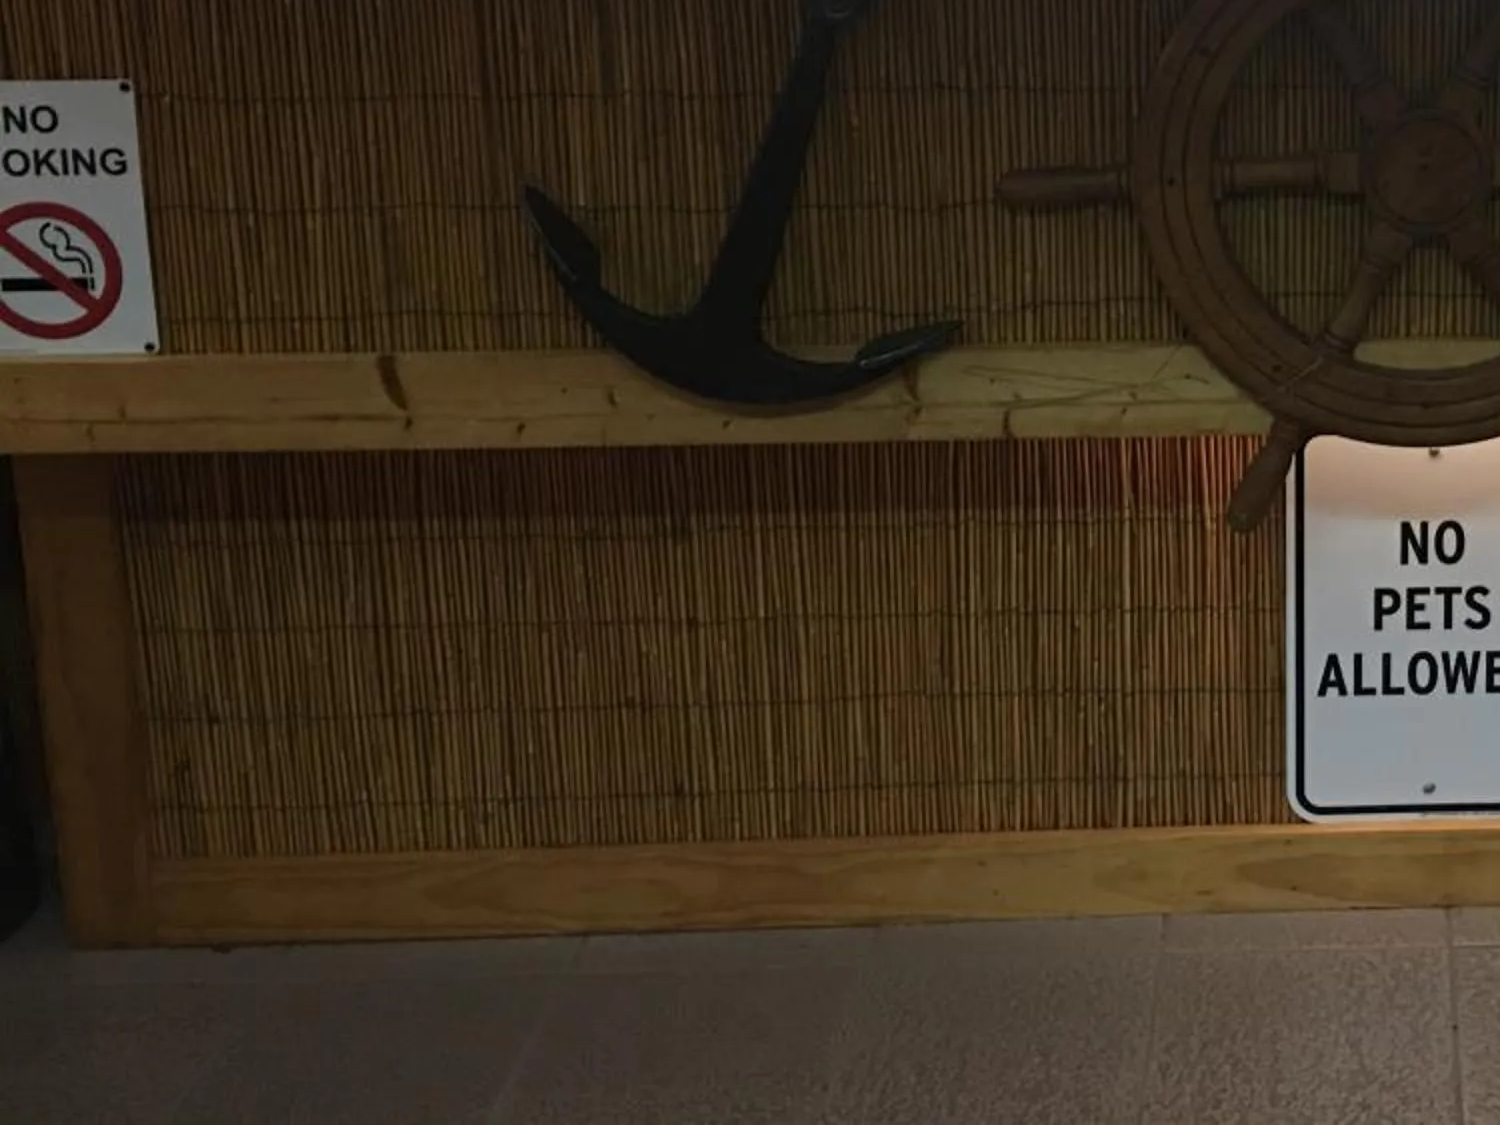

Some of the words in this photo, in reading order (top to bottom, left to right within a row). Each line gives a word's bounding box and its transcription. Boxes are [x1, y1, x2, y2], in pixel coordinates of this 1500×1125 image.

[1, 105, 59, 133] NO
[1399, 520, 1466, 565] NO
[1372, 586, 1492, 631] PETS
